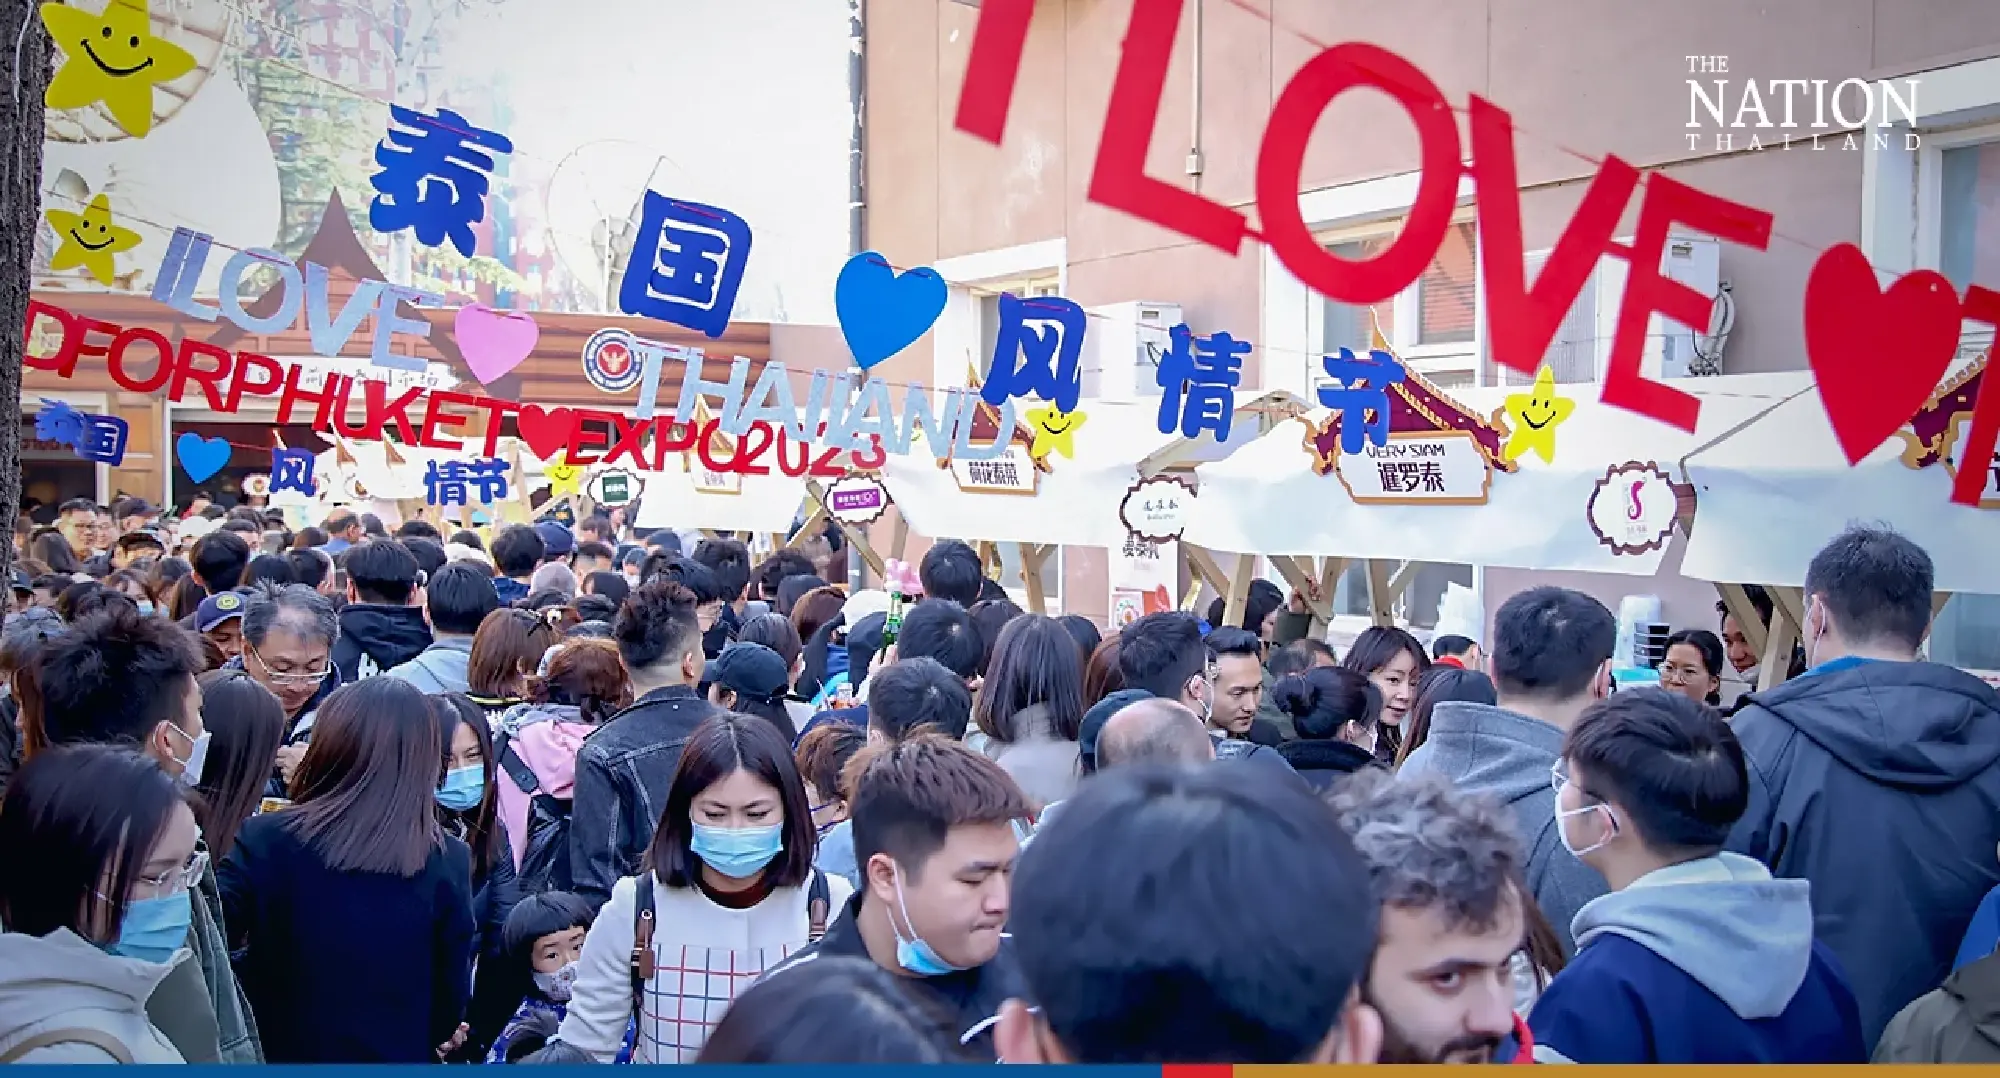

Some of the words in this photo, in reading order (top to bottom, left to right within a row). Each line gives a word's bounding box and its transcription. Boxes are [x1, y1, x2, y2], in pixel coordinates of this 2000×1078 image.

[1408, 443, 1446, 457] SIAM
[1376, 461, 1446, 493] 暹罗泰
